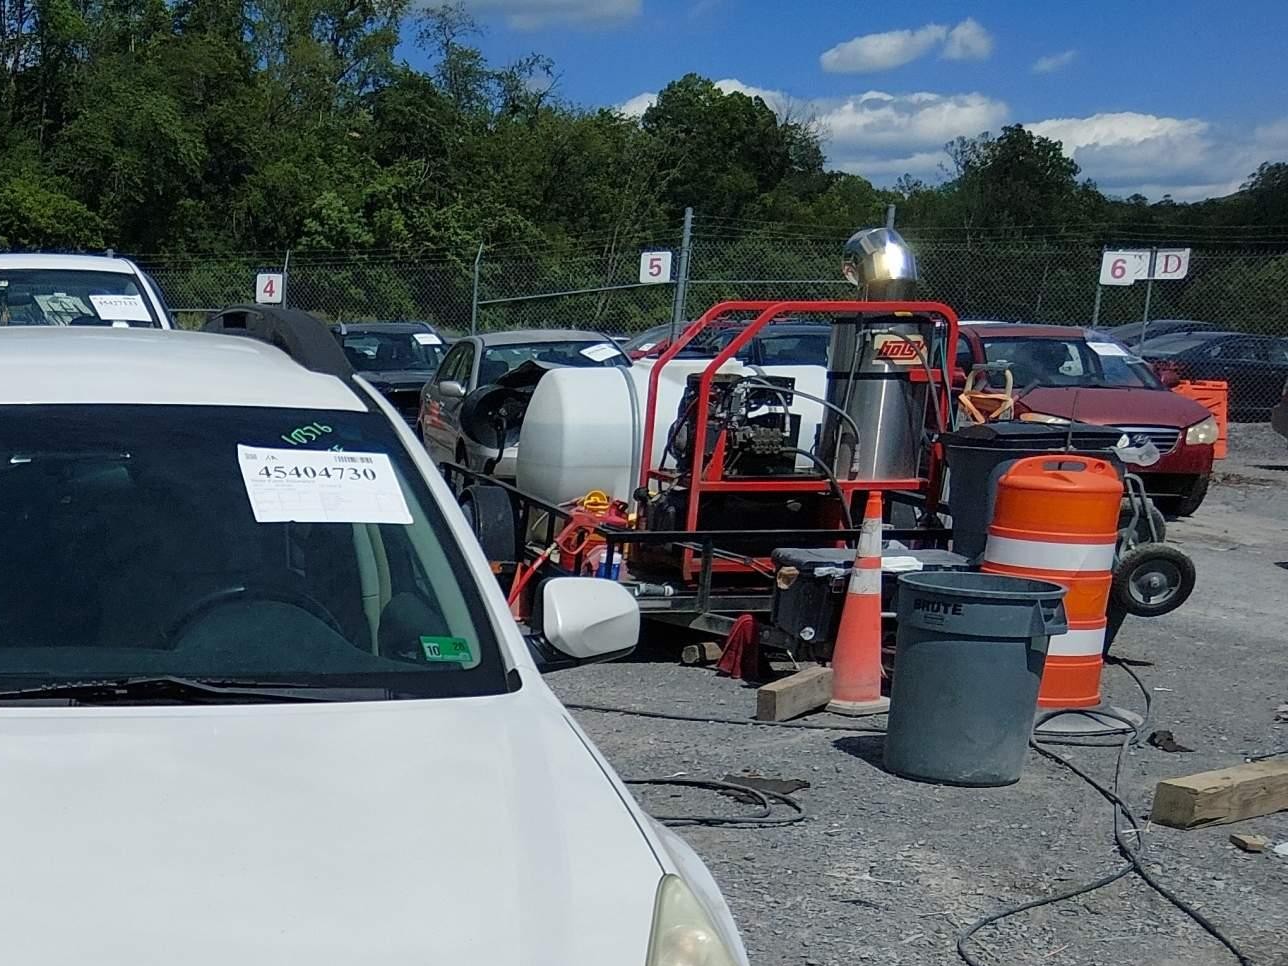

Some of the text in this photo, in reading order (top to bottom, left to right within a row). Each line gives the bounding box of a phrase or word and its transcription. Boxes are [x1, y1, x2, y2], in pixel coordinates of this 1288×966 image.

[649, 258, 662, 277] 5
[1111, 258, 1127, 279] 6
[1161, 254, 1182, 274] D
[263, 279, 275, 297] 4
[258, 466, 377, 481] 45404730
[914, 599, 963, 616] BRUTE
[427, 645, 440, 656] 10
